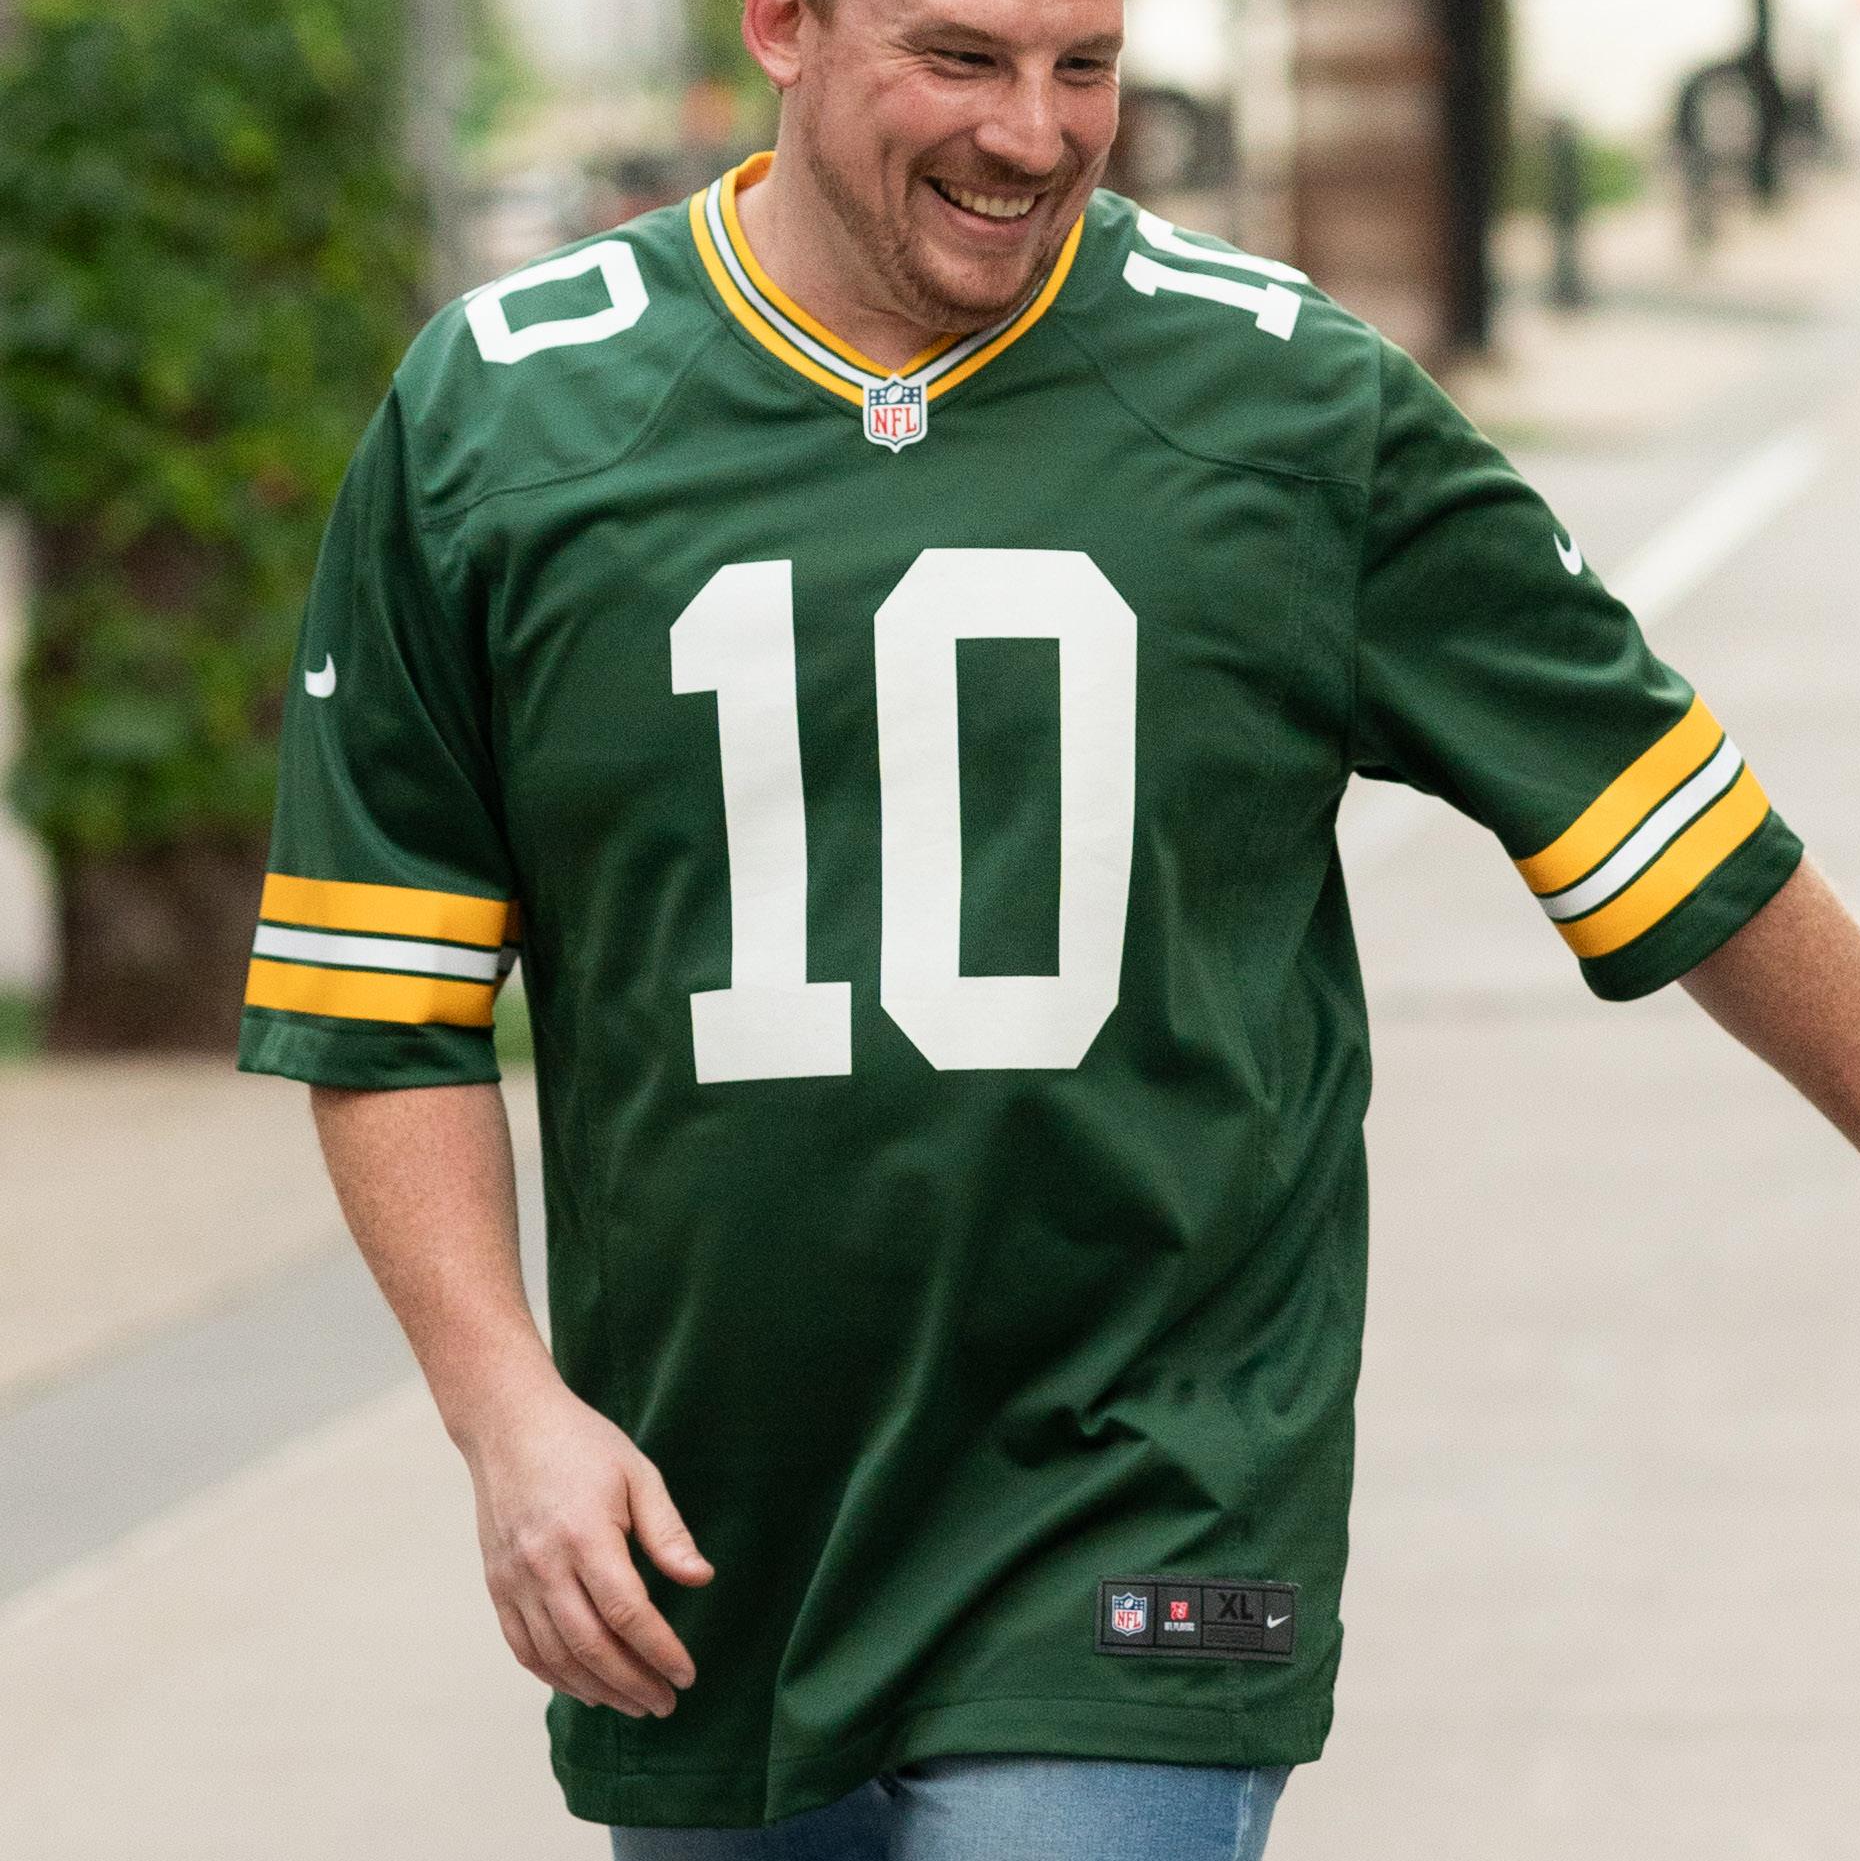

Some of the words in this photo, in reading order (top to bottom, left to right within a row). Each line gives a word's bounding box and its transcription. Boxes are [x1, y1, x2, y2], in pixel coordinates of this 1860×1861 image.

[873, 406, 918, 438] NFL
[669, 547, 1139, 1084] 10
[1115, 1610, 1142, 1630] NFL
[1216, 1591, 1254, 1621] XL
